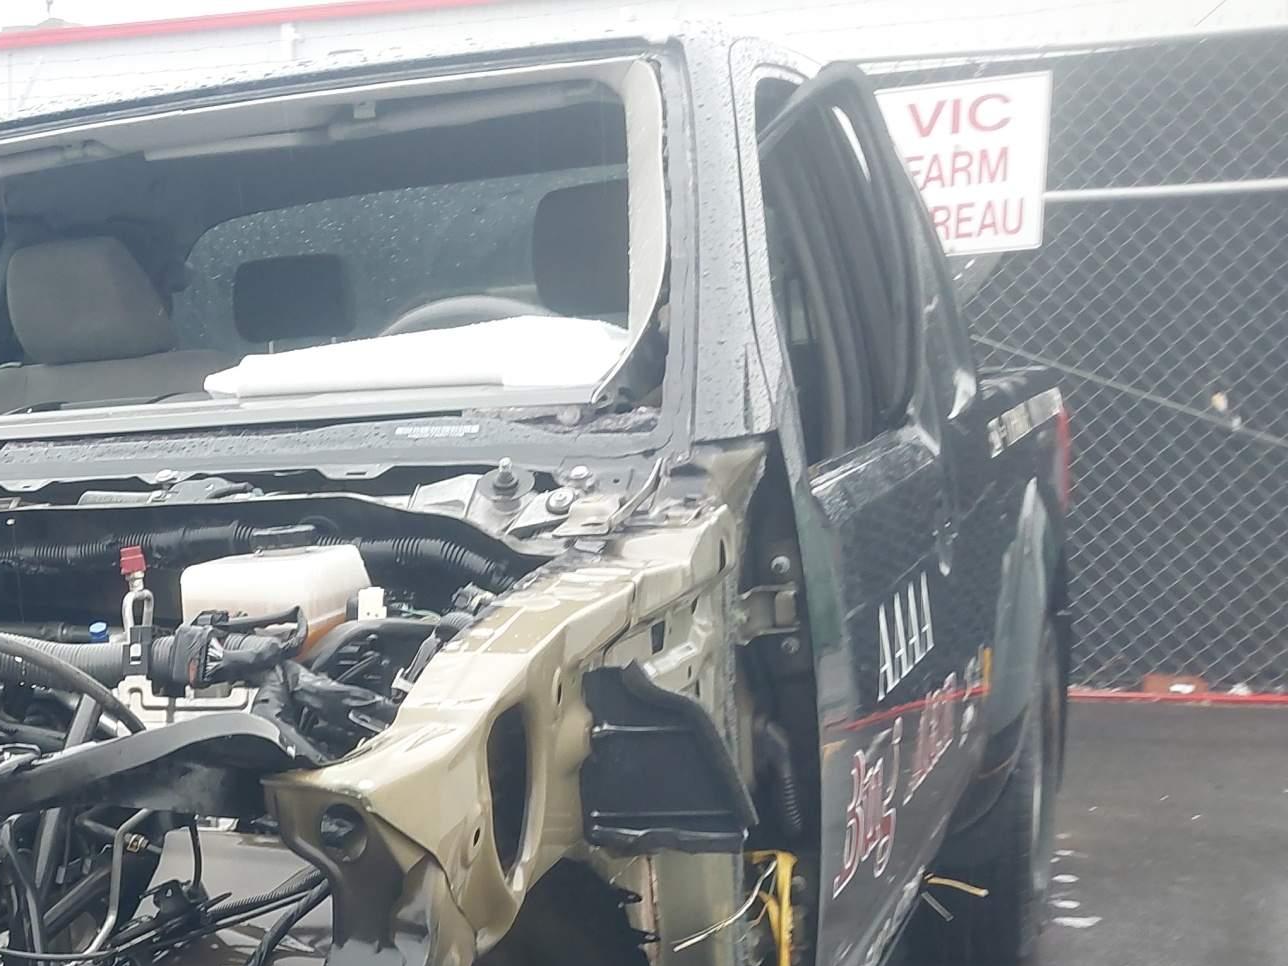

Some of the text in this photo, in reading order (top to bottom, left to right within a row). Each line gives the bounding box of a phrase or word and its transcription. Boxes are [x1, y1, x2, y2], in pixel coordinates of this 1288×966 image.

[907, 93, 1012, 138] VIC
[930, 197, 1025, 241] REAU
[877, 570, 935, 702] AAAA
